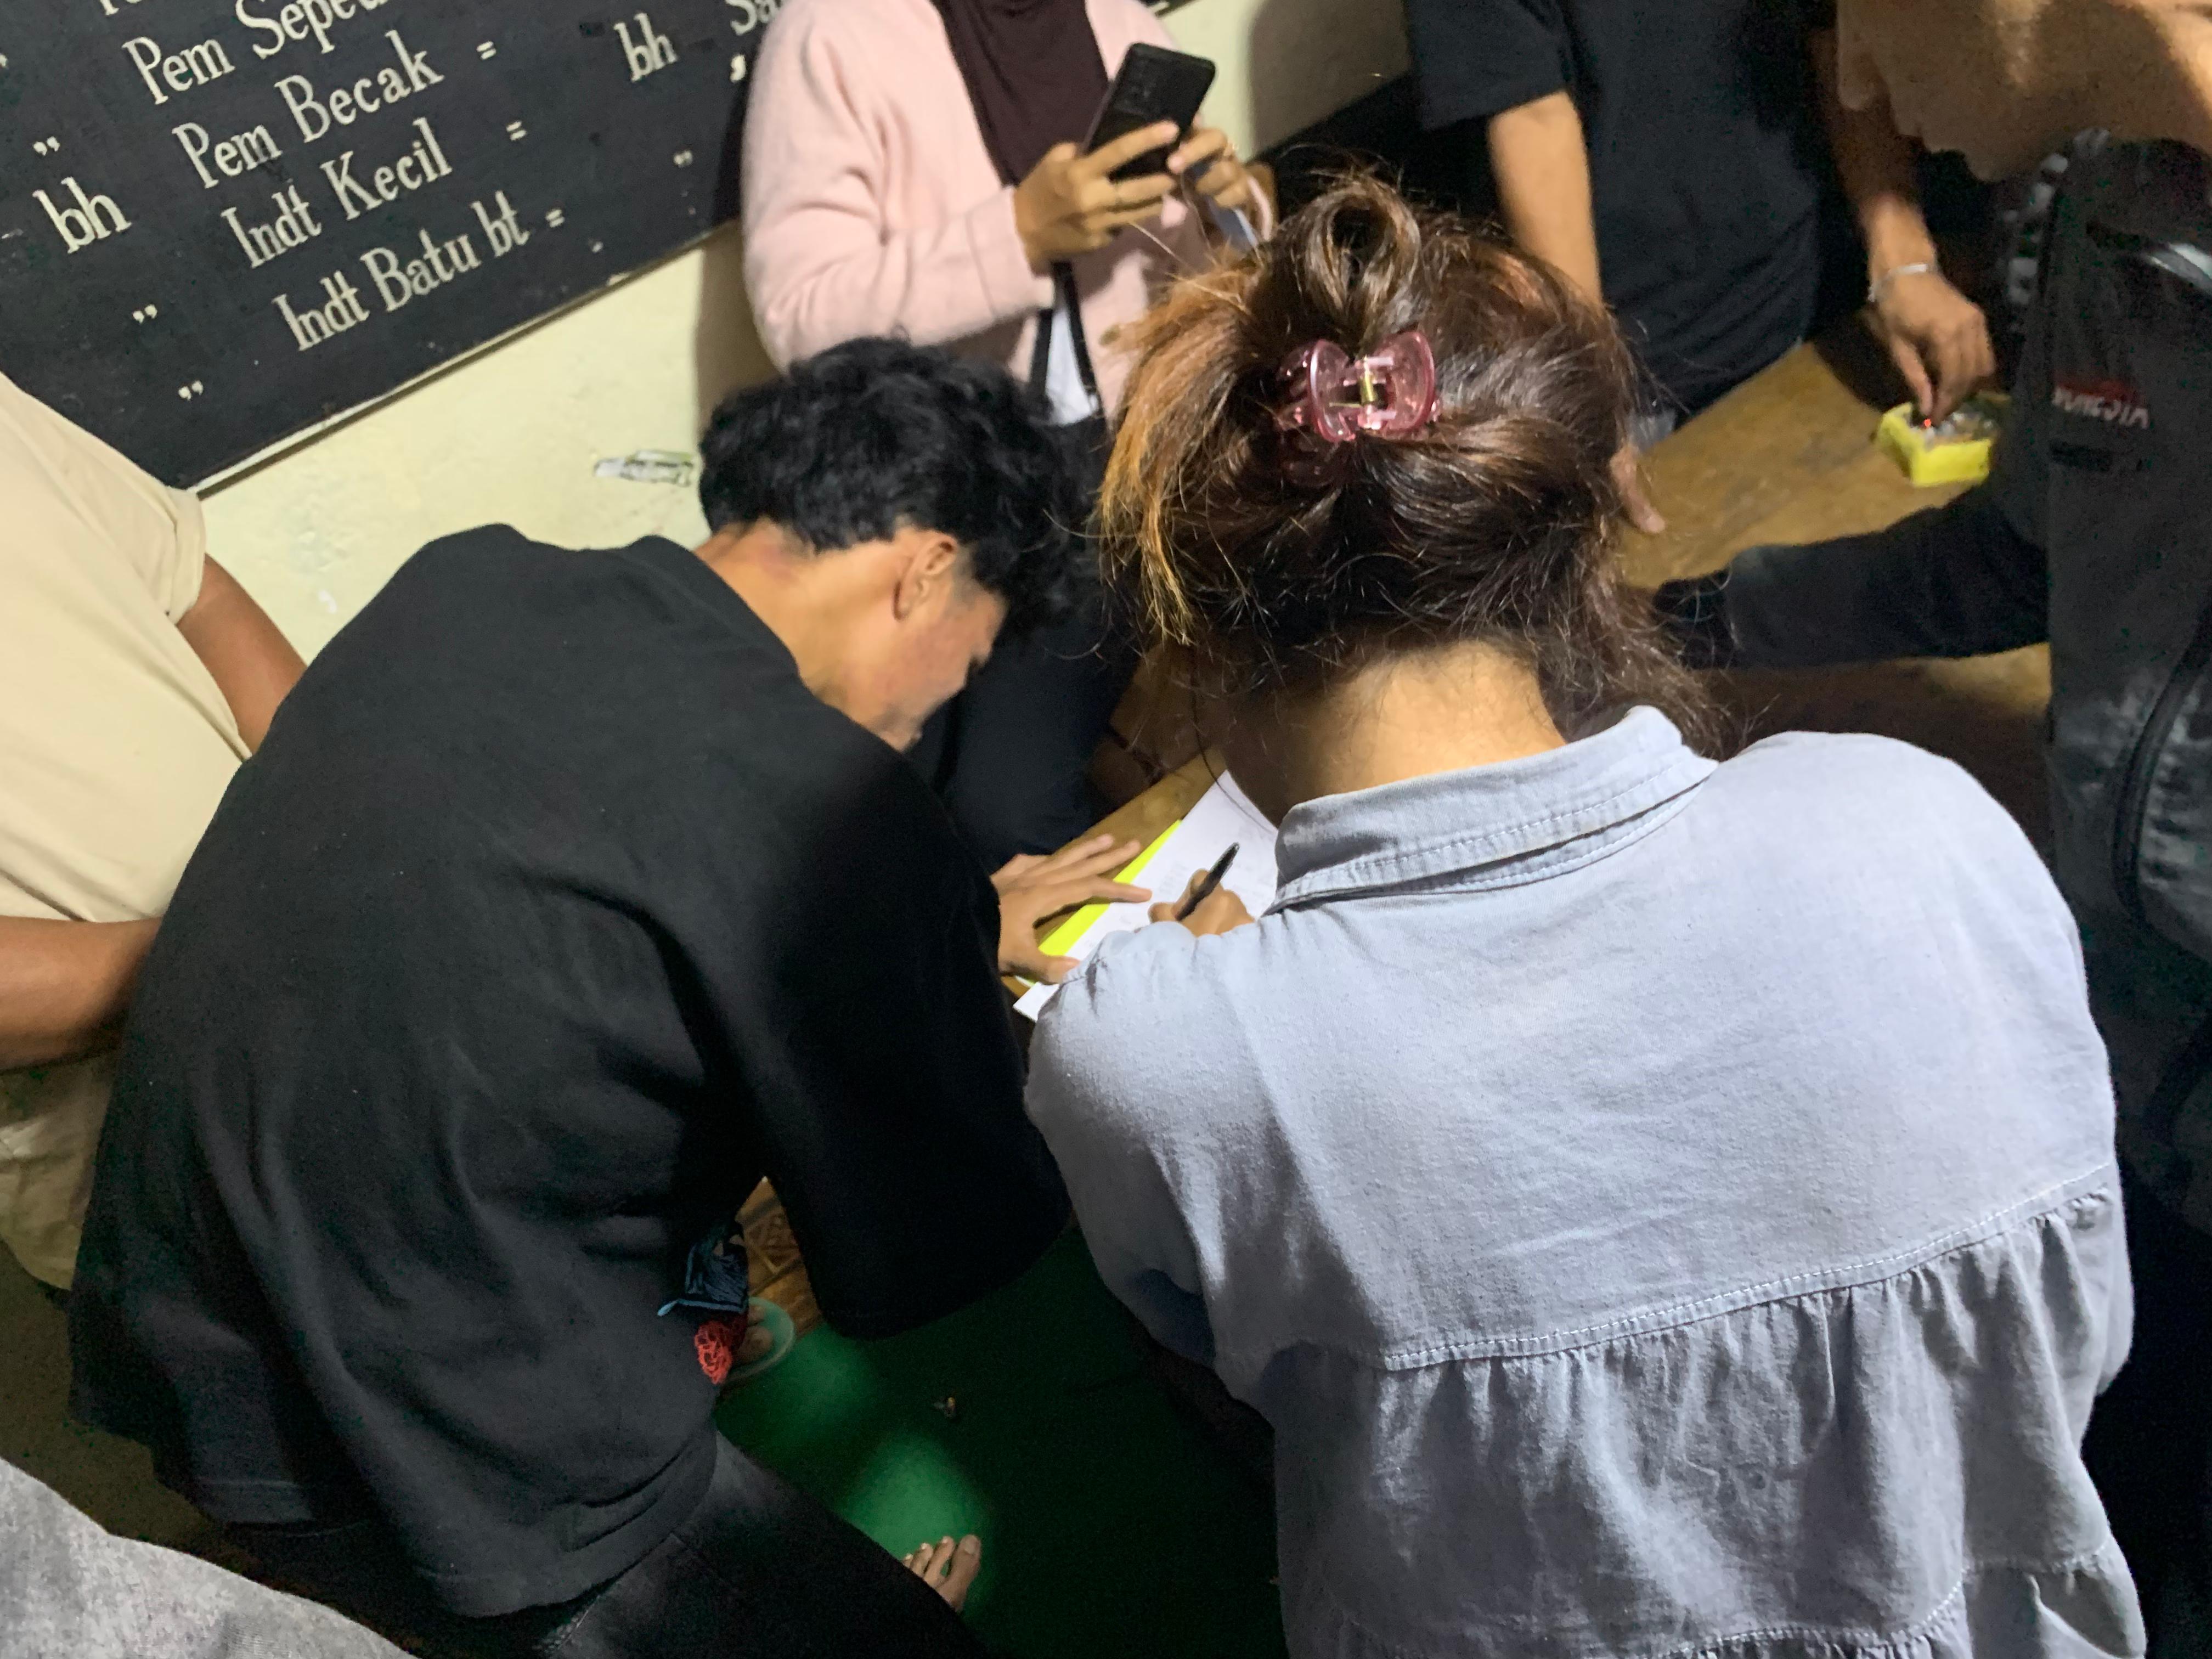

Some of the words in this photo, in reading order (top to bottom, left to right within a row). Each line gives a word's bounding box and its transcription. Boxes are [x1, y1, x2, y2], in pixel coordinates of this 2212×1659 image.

[121, 36, 235, 105] Pem
[235, 0, 387, 59] Sepe
[171, 122, 283, 189] Pem
[274, 29, 445, 143] Becak
[32, 177, 132, 254] bh
[221, 185, 321, 268] Indt
[320, 117, 453, 220] Kecil
[613, 13, 678, 81] bh
[273, 270, 370, 351] Indt
[359, 229, 481, 312] Batu
[471, 190, 530, 257] bt
